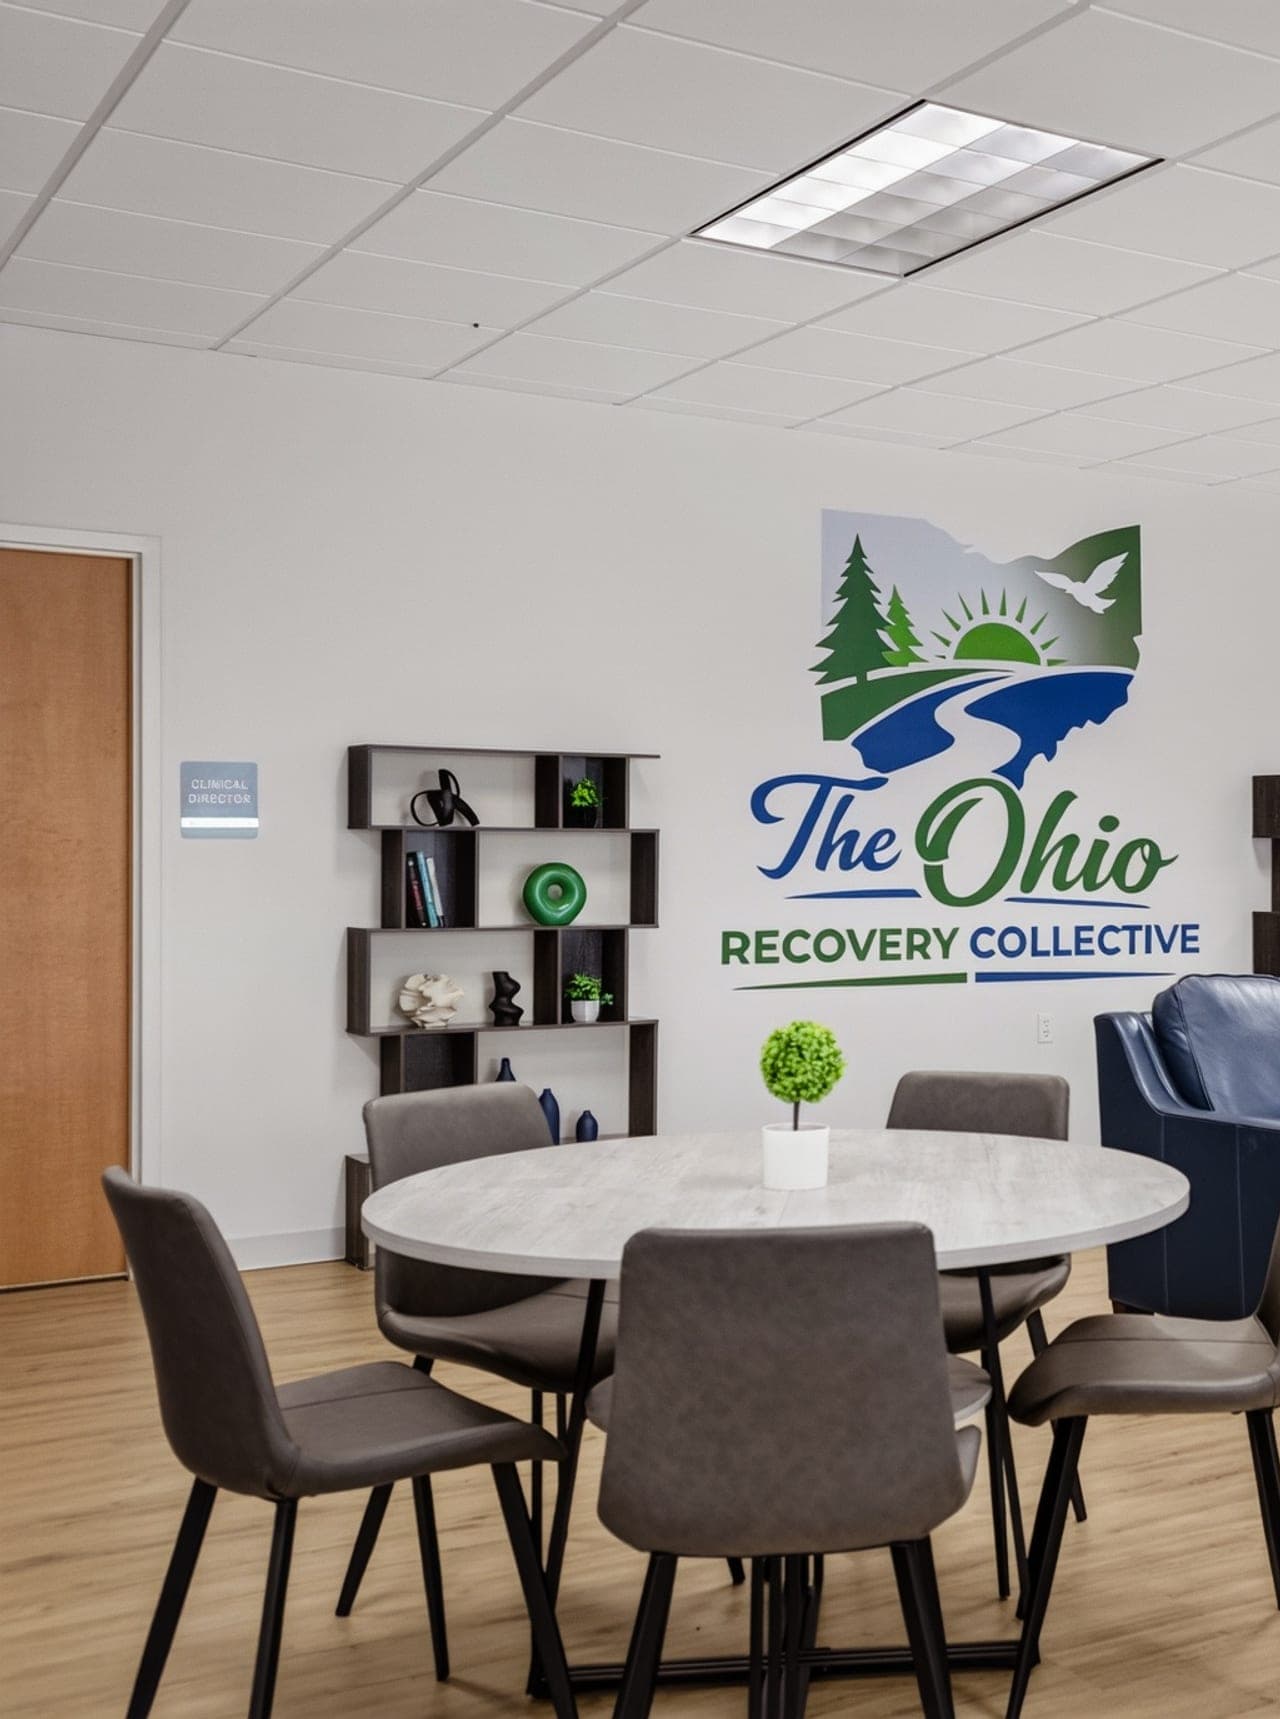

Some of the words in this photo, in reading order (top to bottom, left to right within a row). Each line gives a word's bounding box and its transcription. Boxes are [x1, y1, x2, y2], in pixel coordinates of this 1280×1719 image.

[191, 779, 248, 789] CLINICAL
[188, 793, 251, 804] DIRECTOR
[750, 774, 902, 880] The
[915, 778, 1179, 907] Ohio
[721, 927, 959, 964] RECOVERY
[970, 923, 1200, 958] COLLECTIVE
